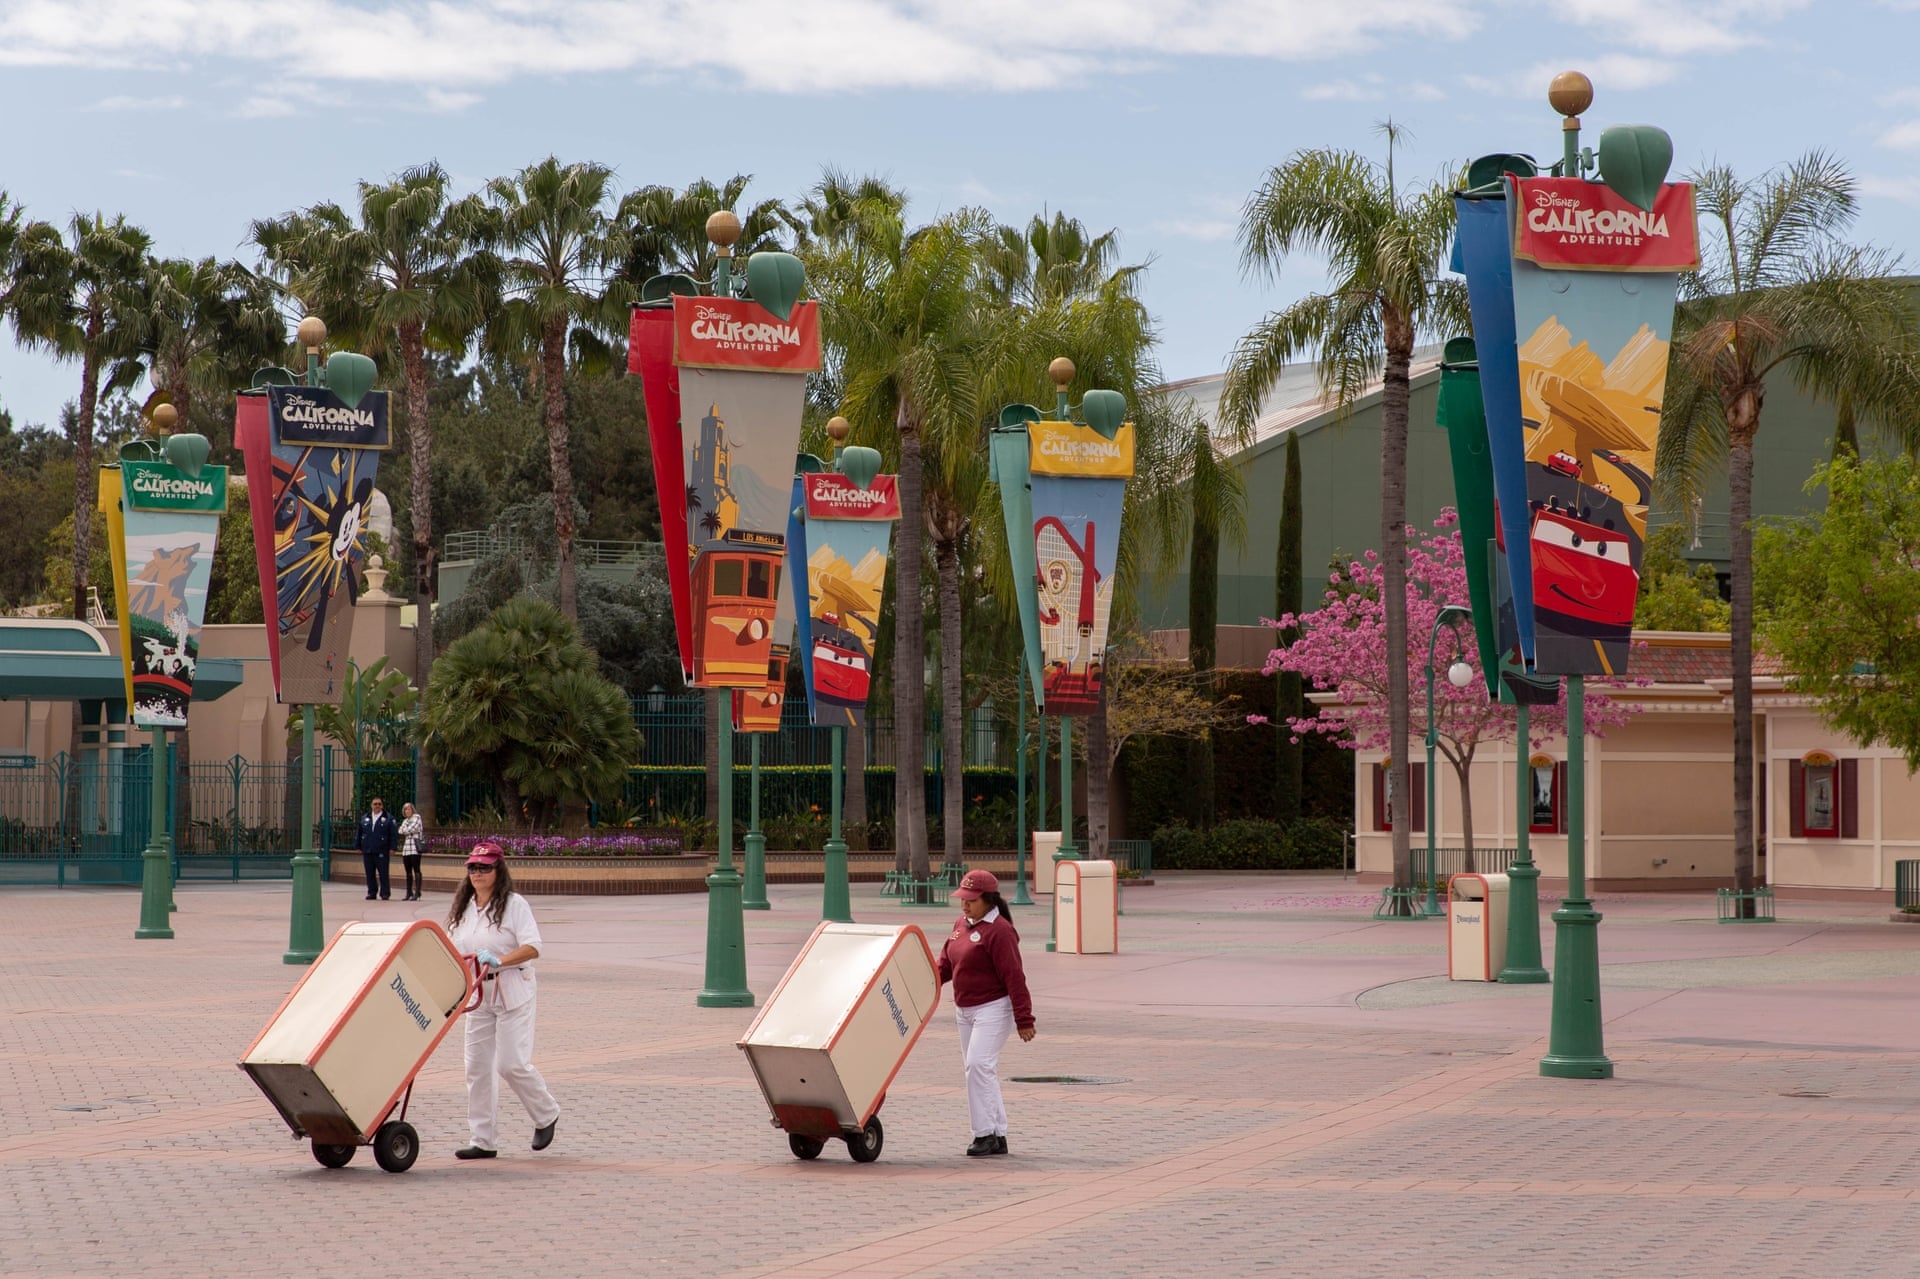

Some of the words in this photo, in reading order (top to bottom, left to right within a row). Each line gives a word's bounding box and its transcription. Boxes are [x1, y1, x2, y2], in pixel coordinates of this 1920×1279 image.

[1532, 189, 1580, 212] Disney
[1527, 208, 1669, 238] CALIFORNIA
[1559, 234, 1641, 246] ADVENTURE
[694, 305, 732, 323] Disney
[691, 320, 800, 346] CALIFORNIA
[716, 341, 779, 352] ADVENTURE
[285, 393, 317, 408] Disney
[282, 405, 375, 427] CALIFORNIA
[302, 423, 356, 432] ADVENTURE
[1040, 440, 1120, 458] CALIFORNIA
[133, 478, 213, 496] CALIFORNIA
[150, 492, 196, 500] ADVENTURE
[813, 488, 886, 504] CALIFORNIA
[829, 501, 871, 509] ADVENTURE
[390, 972, 432, 1031] Disneyland
[881, 977, 909, 1037] Disneyland
